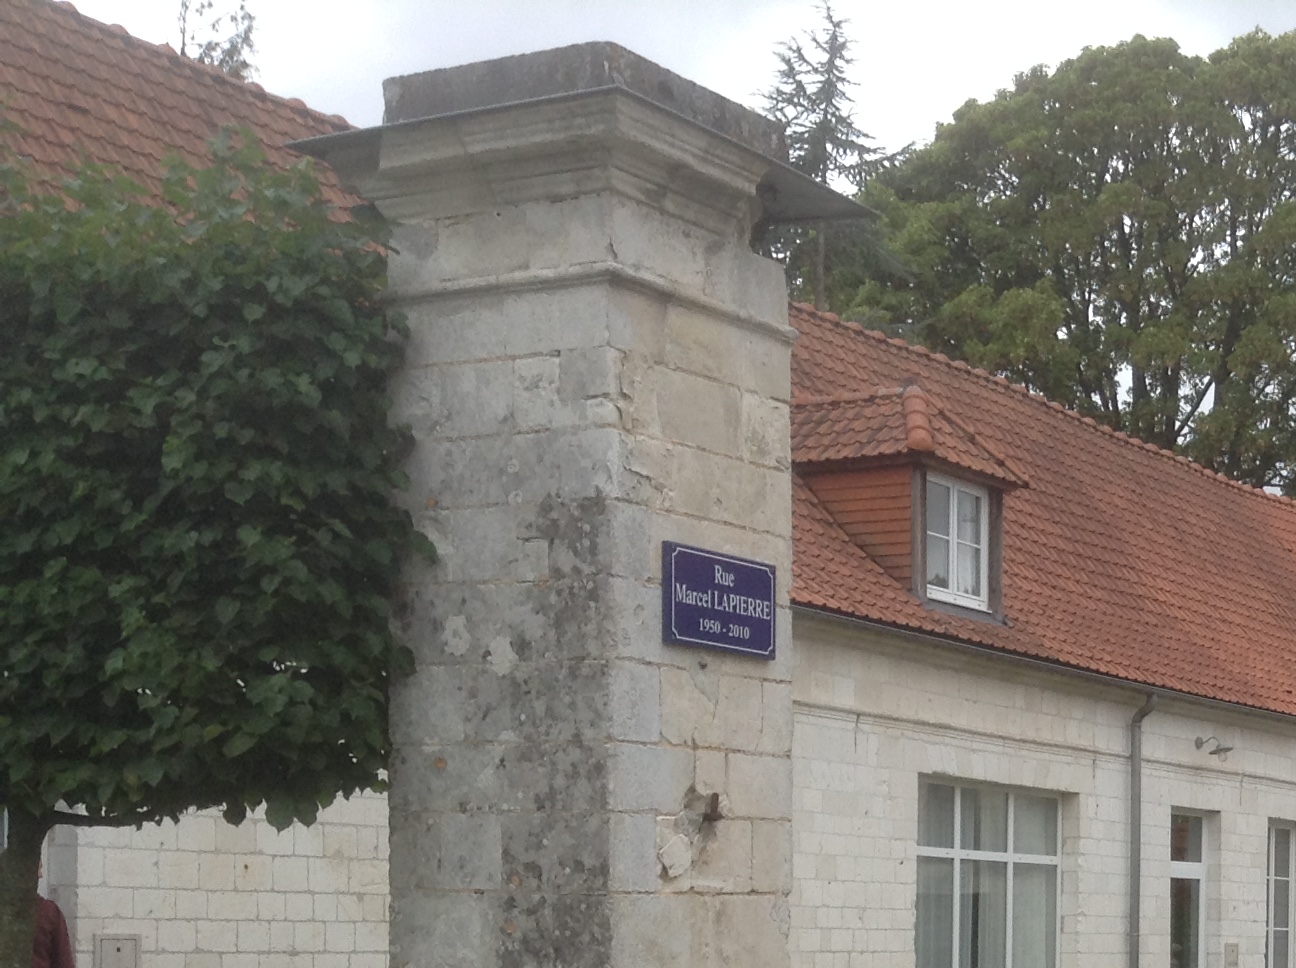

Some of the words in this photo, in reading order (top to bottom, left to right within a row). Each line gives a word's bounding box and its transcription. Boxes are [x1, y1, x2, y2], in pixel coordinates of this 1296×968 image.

[714, 565, 735, 587] Rue
[675, 583, 712, 608] Marcel
[714, 590, 771, 620] LAPIERRE
[699, 618, 720, 634] 1950
[728, 624, 750, 639] 2010
